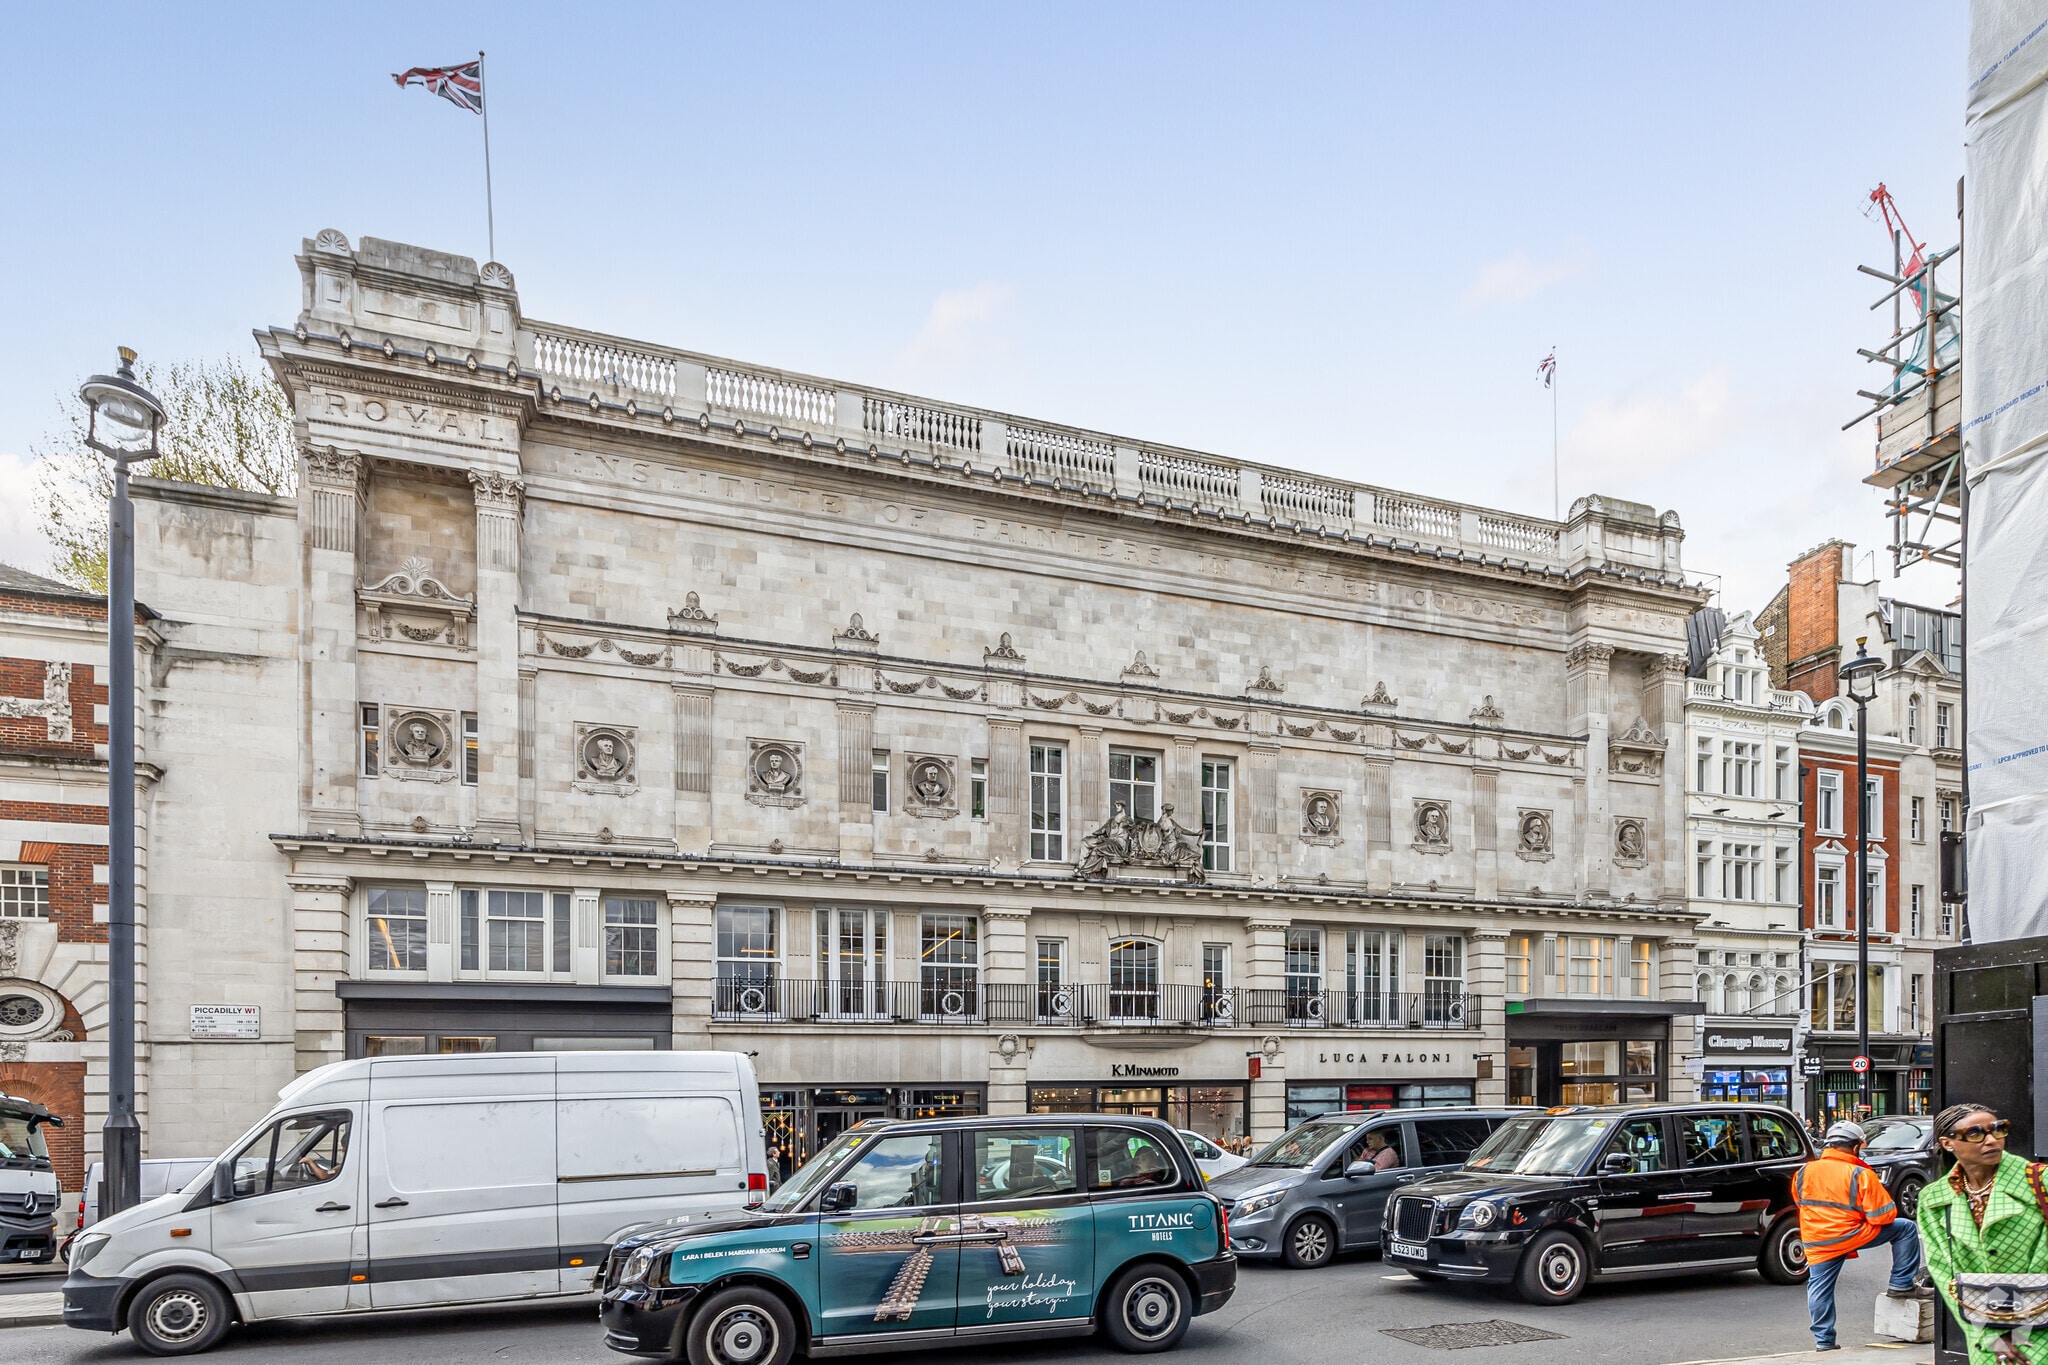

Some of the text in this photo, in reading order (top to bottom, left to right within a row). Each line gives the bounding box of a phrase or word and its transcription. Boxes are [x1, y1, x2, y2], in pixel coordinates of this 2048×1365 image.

[325, 393, 503, 441] ROYAL
[573, 452, 842, 513] INSTITUTE
[883, 504, 929, 527] OF
[972, 518, 1163, 566] PAINTERS
[1199, 554, 1230, 577] IN
[1264, 565, 1379, 601] WATER
[1412, 590, 1545, 625] COLOURS
[2012, 747, 2038, 760] APPROVED
[2039, 745, 2046, 753] TO
[1708, 1034, 1790, 1050] Change Money
[1319, 1053, 1451, 1063] LUCA FALONI
[1854, 1060, 1866, 1068] 20
[1128, 1212, 1194, 1228] TITANIC
[1151, 1231, 1173, 1241] HOTELS
[986, 1282, 1019, 1302] your
[986, 1299, 1019, 1319] your
